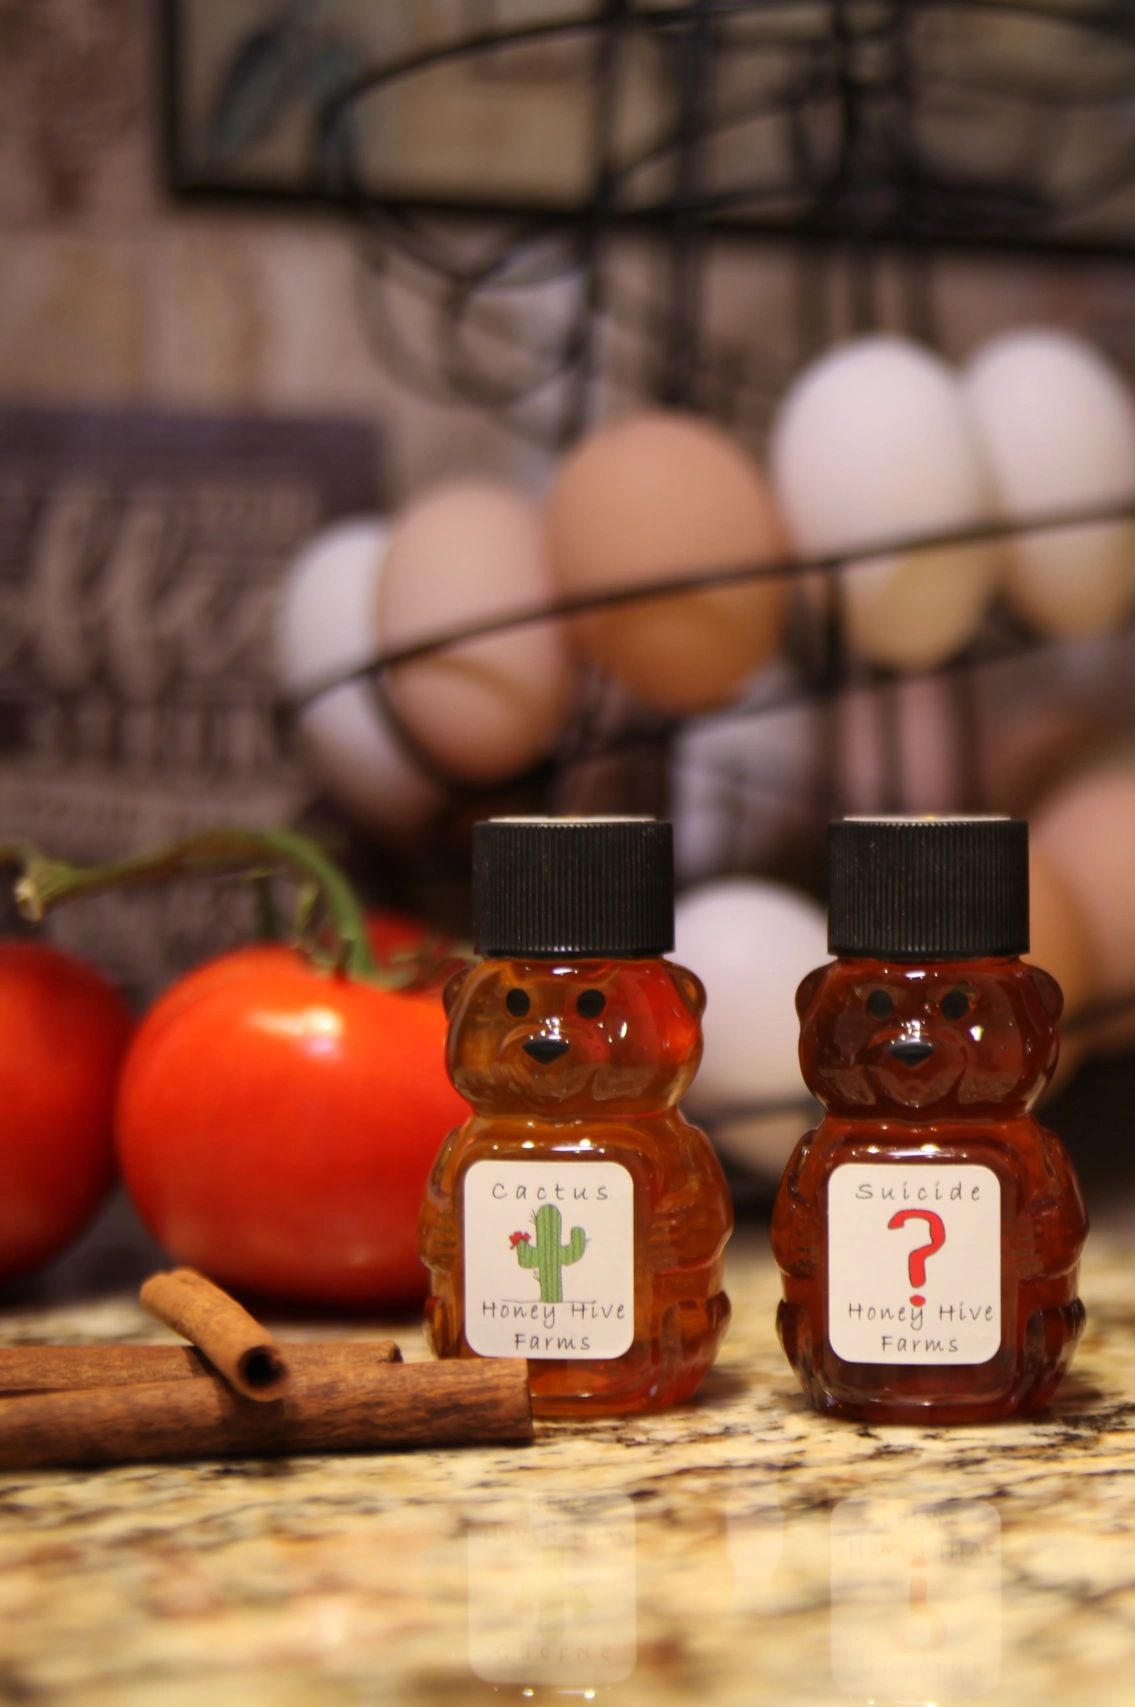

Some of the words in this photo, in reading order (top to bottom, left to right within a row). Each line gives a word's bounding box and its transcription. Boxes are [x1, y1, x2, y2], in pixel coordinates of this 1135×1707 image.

[492, 1183, 608, 1200] Cactus
[855, 1181, 981, 1201] Suicide
[482, 1302, 555, 1329] Honey
[571, 1303, 625, 1320] Hive
[848, 1303, 923, 1330] Honey
[939, 1302, 993, 1321] Hive
[514, 1333, 591, 1350] Farms
[881, 1336, 958, 1352] Farms
